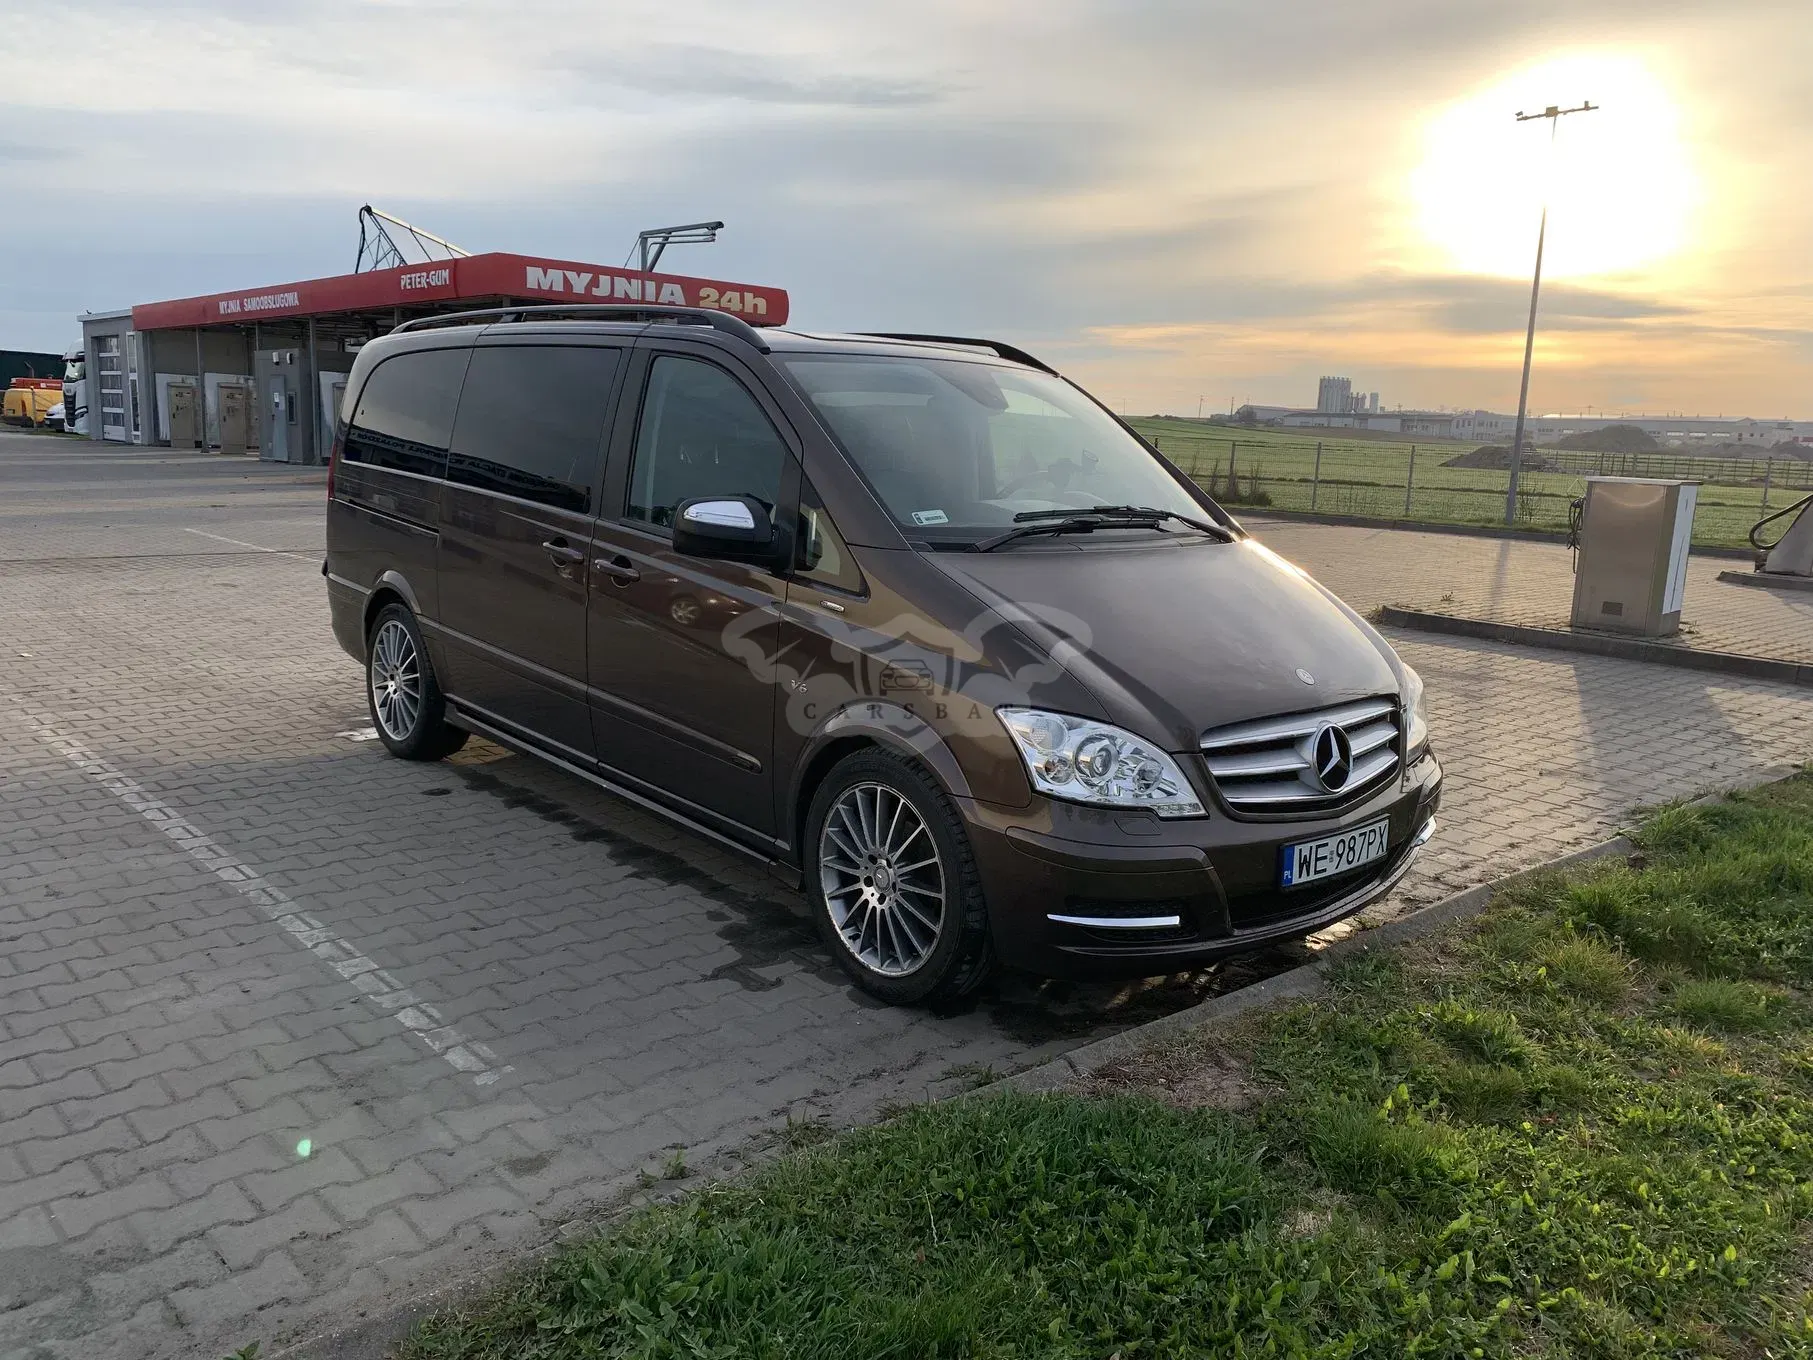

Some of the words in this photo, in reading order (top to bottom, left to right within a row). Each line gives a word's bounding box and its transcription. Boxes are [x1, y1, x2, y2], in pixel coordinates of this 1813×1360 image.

[400, 269, 449, 290] PETER-GUM
[526, 266, 687, 306] MYJNIA
[699, 287, 767, 315] 24h
[791, 679, 807, 693] V6
[1298, 842, 1329, 879] WE
[1335, 823, 1388, 870] 987PX
[1283, 870, 1292, 880] PL
